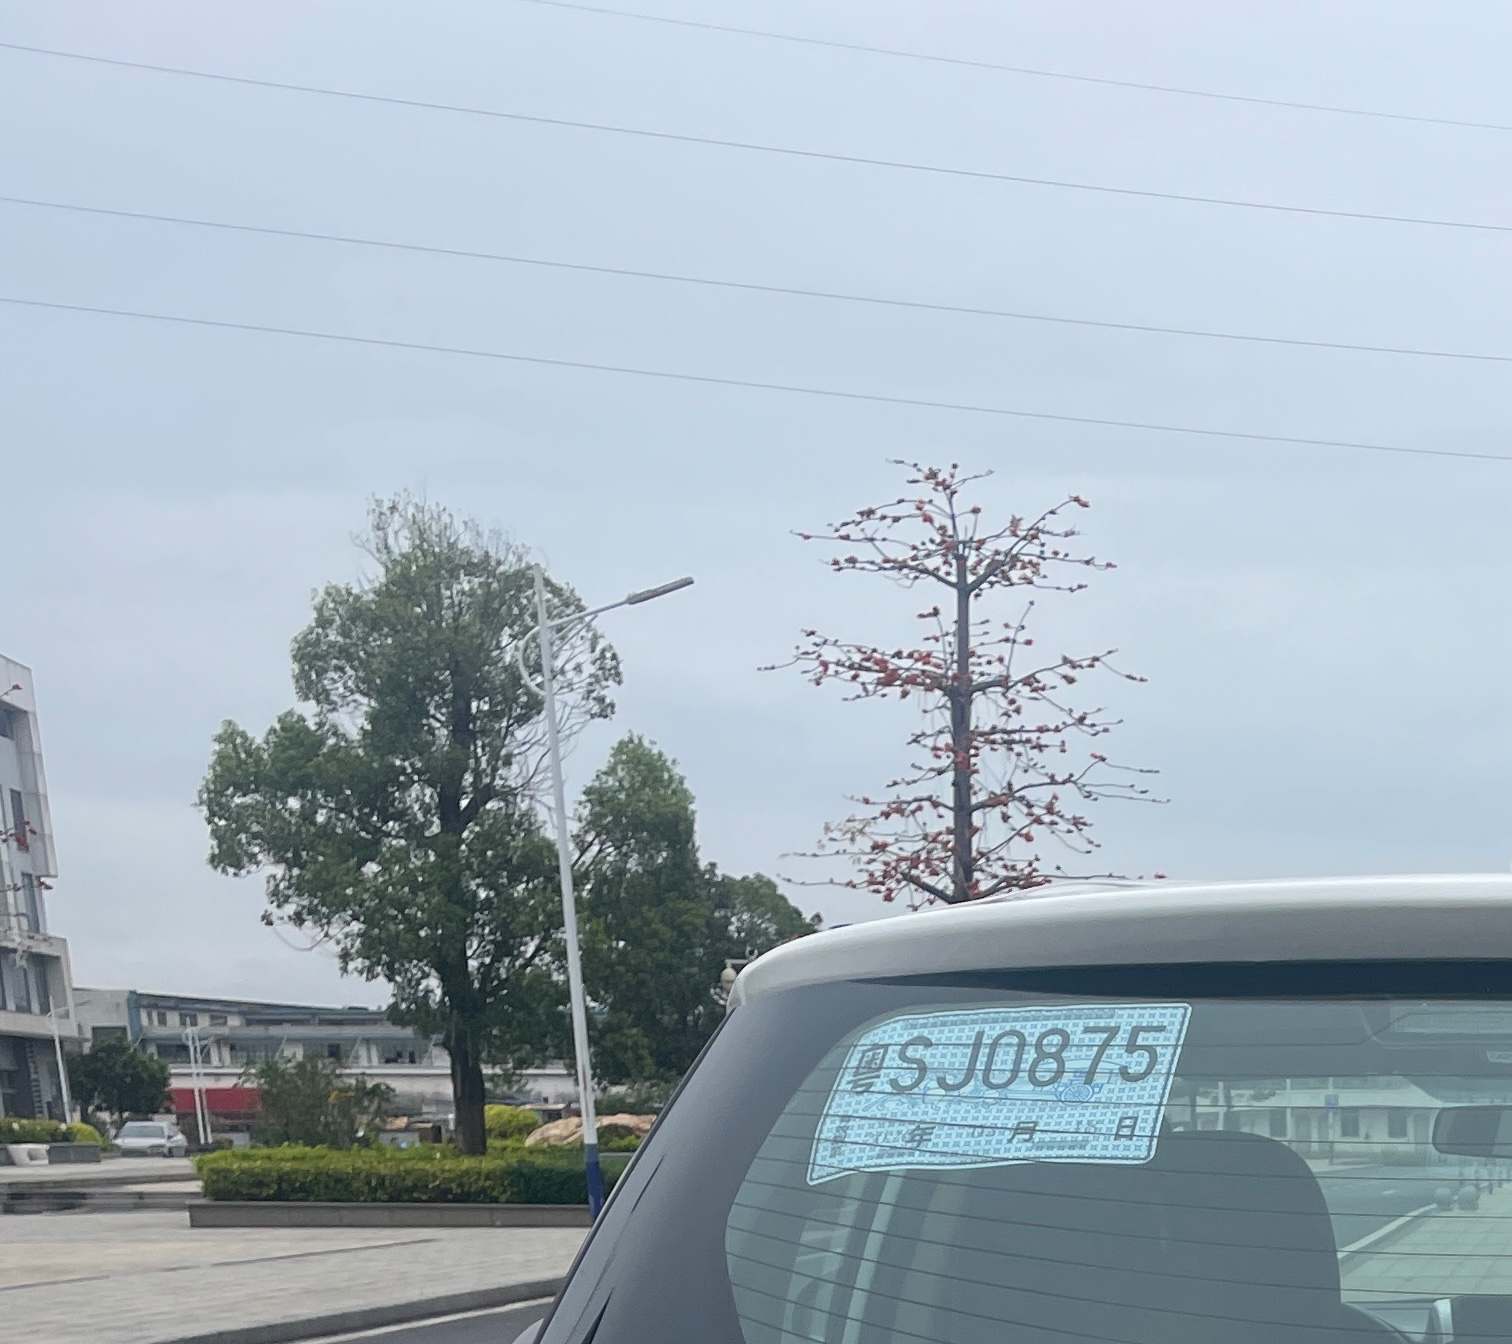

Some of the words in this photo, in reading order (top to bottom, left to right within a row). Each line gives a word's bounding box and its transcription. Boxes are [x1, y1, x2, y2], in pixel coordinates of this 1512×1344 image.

[846, 1025, 1168, 1094] 粤SJ0875
[1007, 1121, 1039, 1144] 月
[1114, 1116, 1139, 1141] 日
